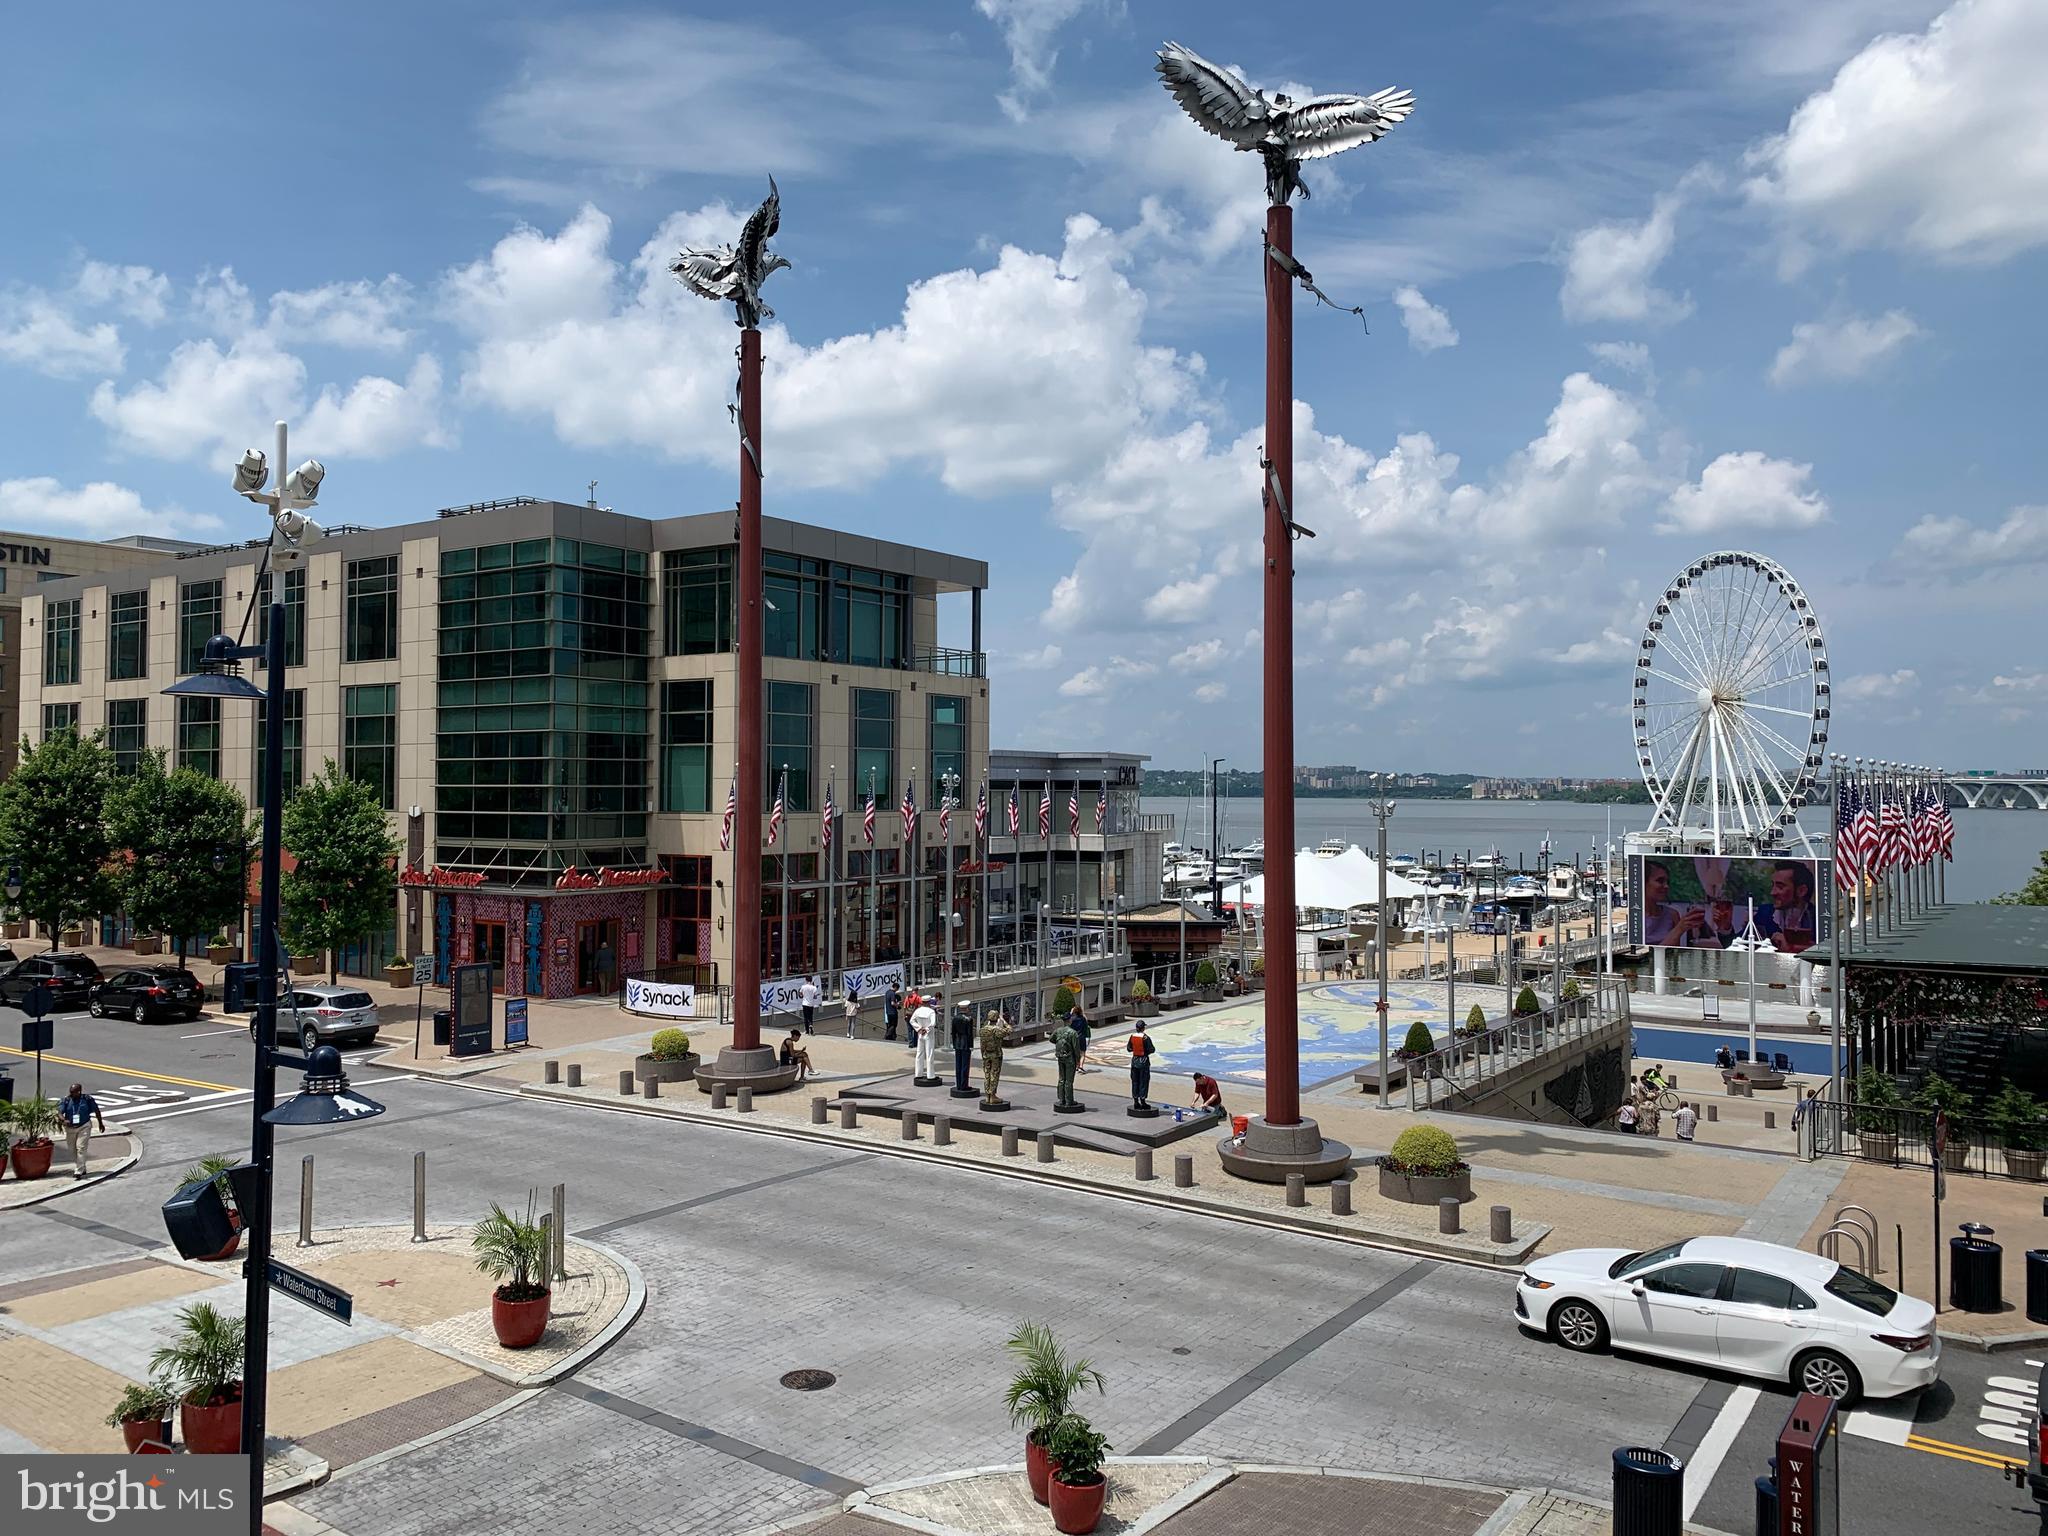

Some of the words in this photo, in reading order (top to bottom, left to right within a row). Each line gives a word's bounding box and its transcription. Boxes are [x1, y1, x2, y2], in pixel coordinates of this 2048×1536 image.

[416, 957, 433, 965] SPEED
[415, 969, 432, 982] 25
[865, 968, 903, 990] Synack
[642, 986, 691, 1007] Synack
[282, 1272, 317, 1301] Waterfront
[316, 1289, 337, 1311] Street
[1789, 1460, 1804, 1534] WATER
